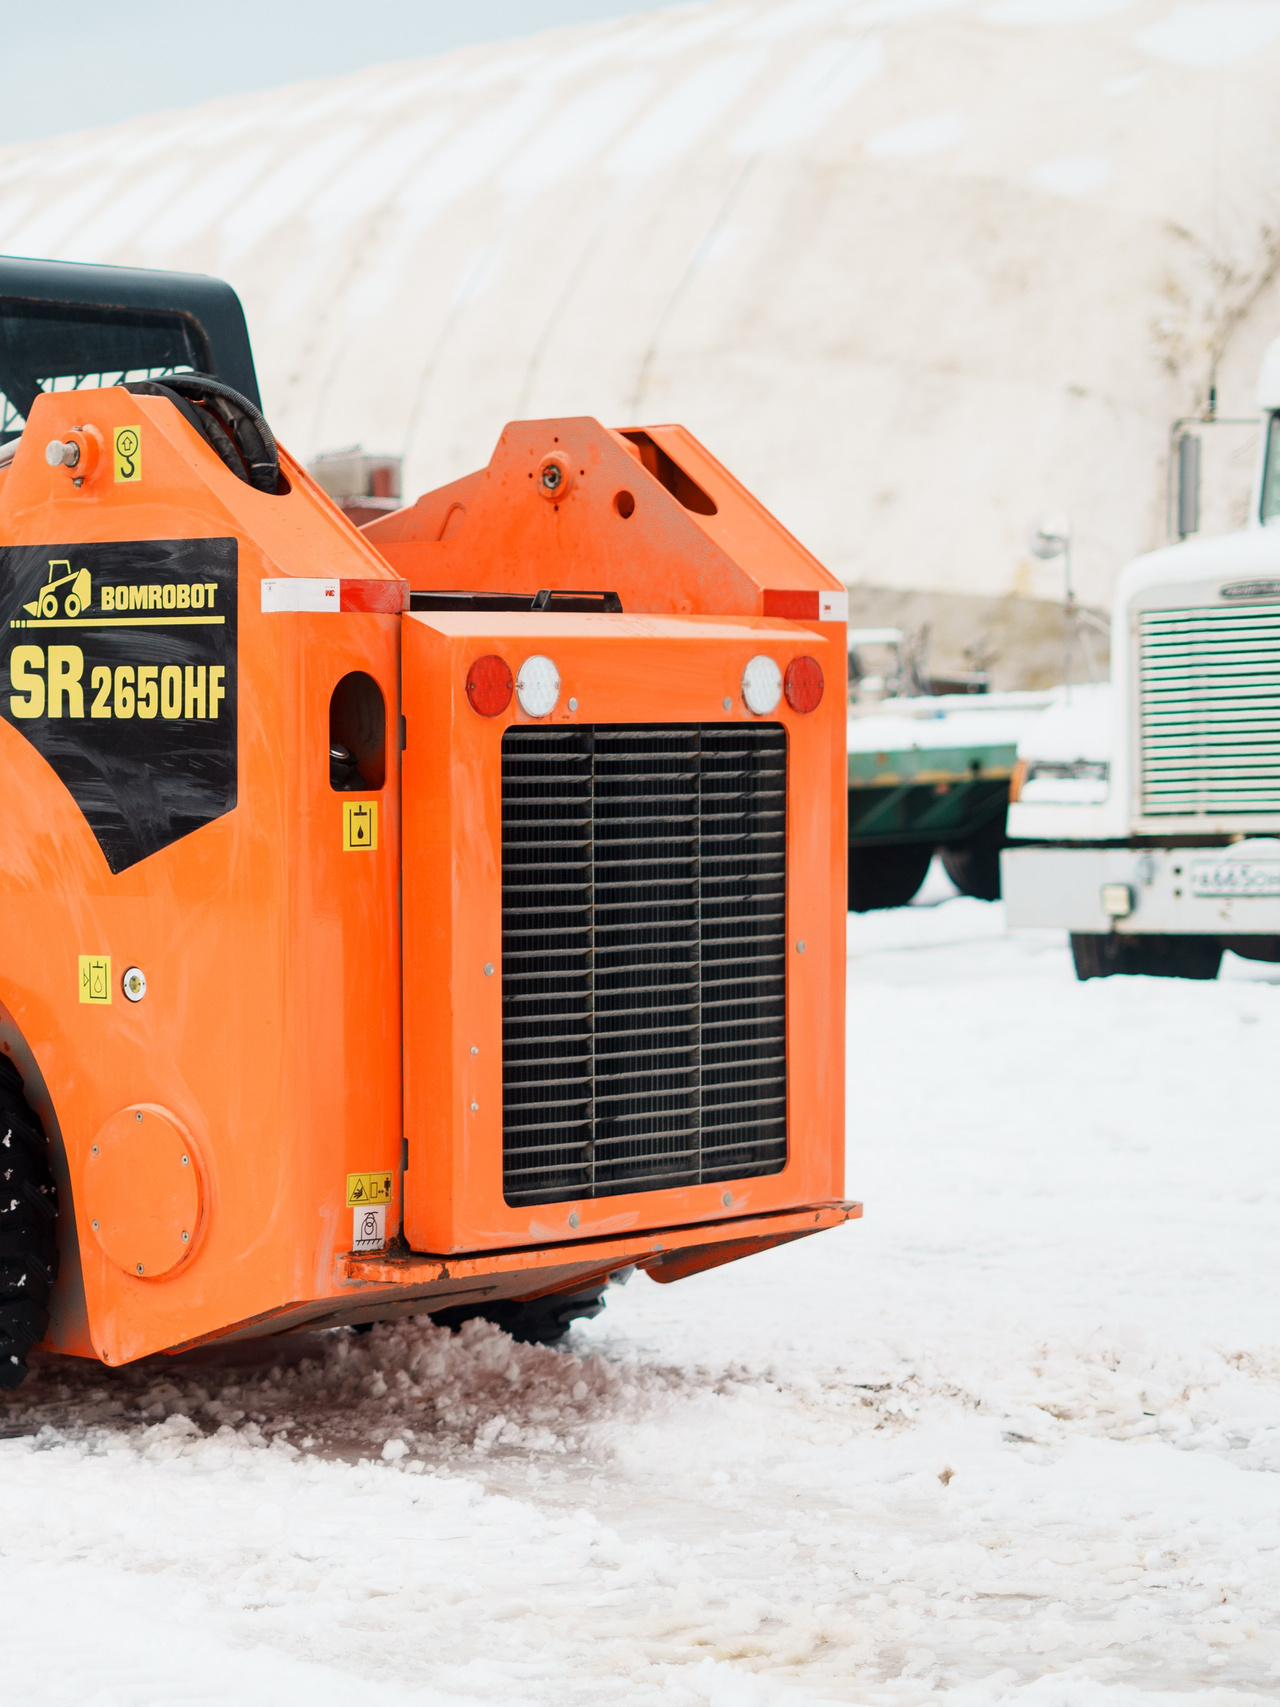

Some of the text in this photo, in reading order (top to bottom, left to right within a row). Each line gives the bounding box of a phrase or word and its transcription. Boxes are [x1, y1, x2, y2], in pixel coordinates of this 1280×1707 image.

[101, 583, 218, 610] BOMROBOT
[10, 645, 225, 719] SR 2650HF
